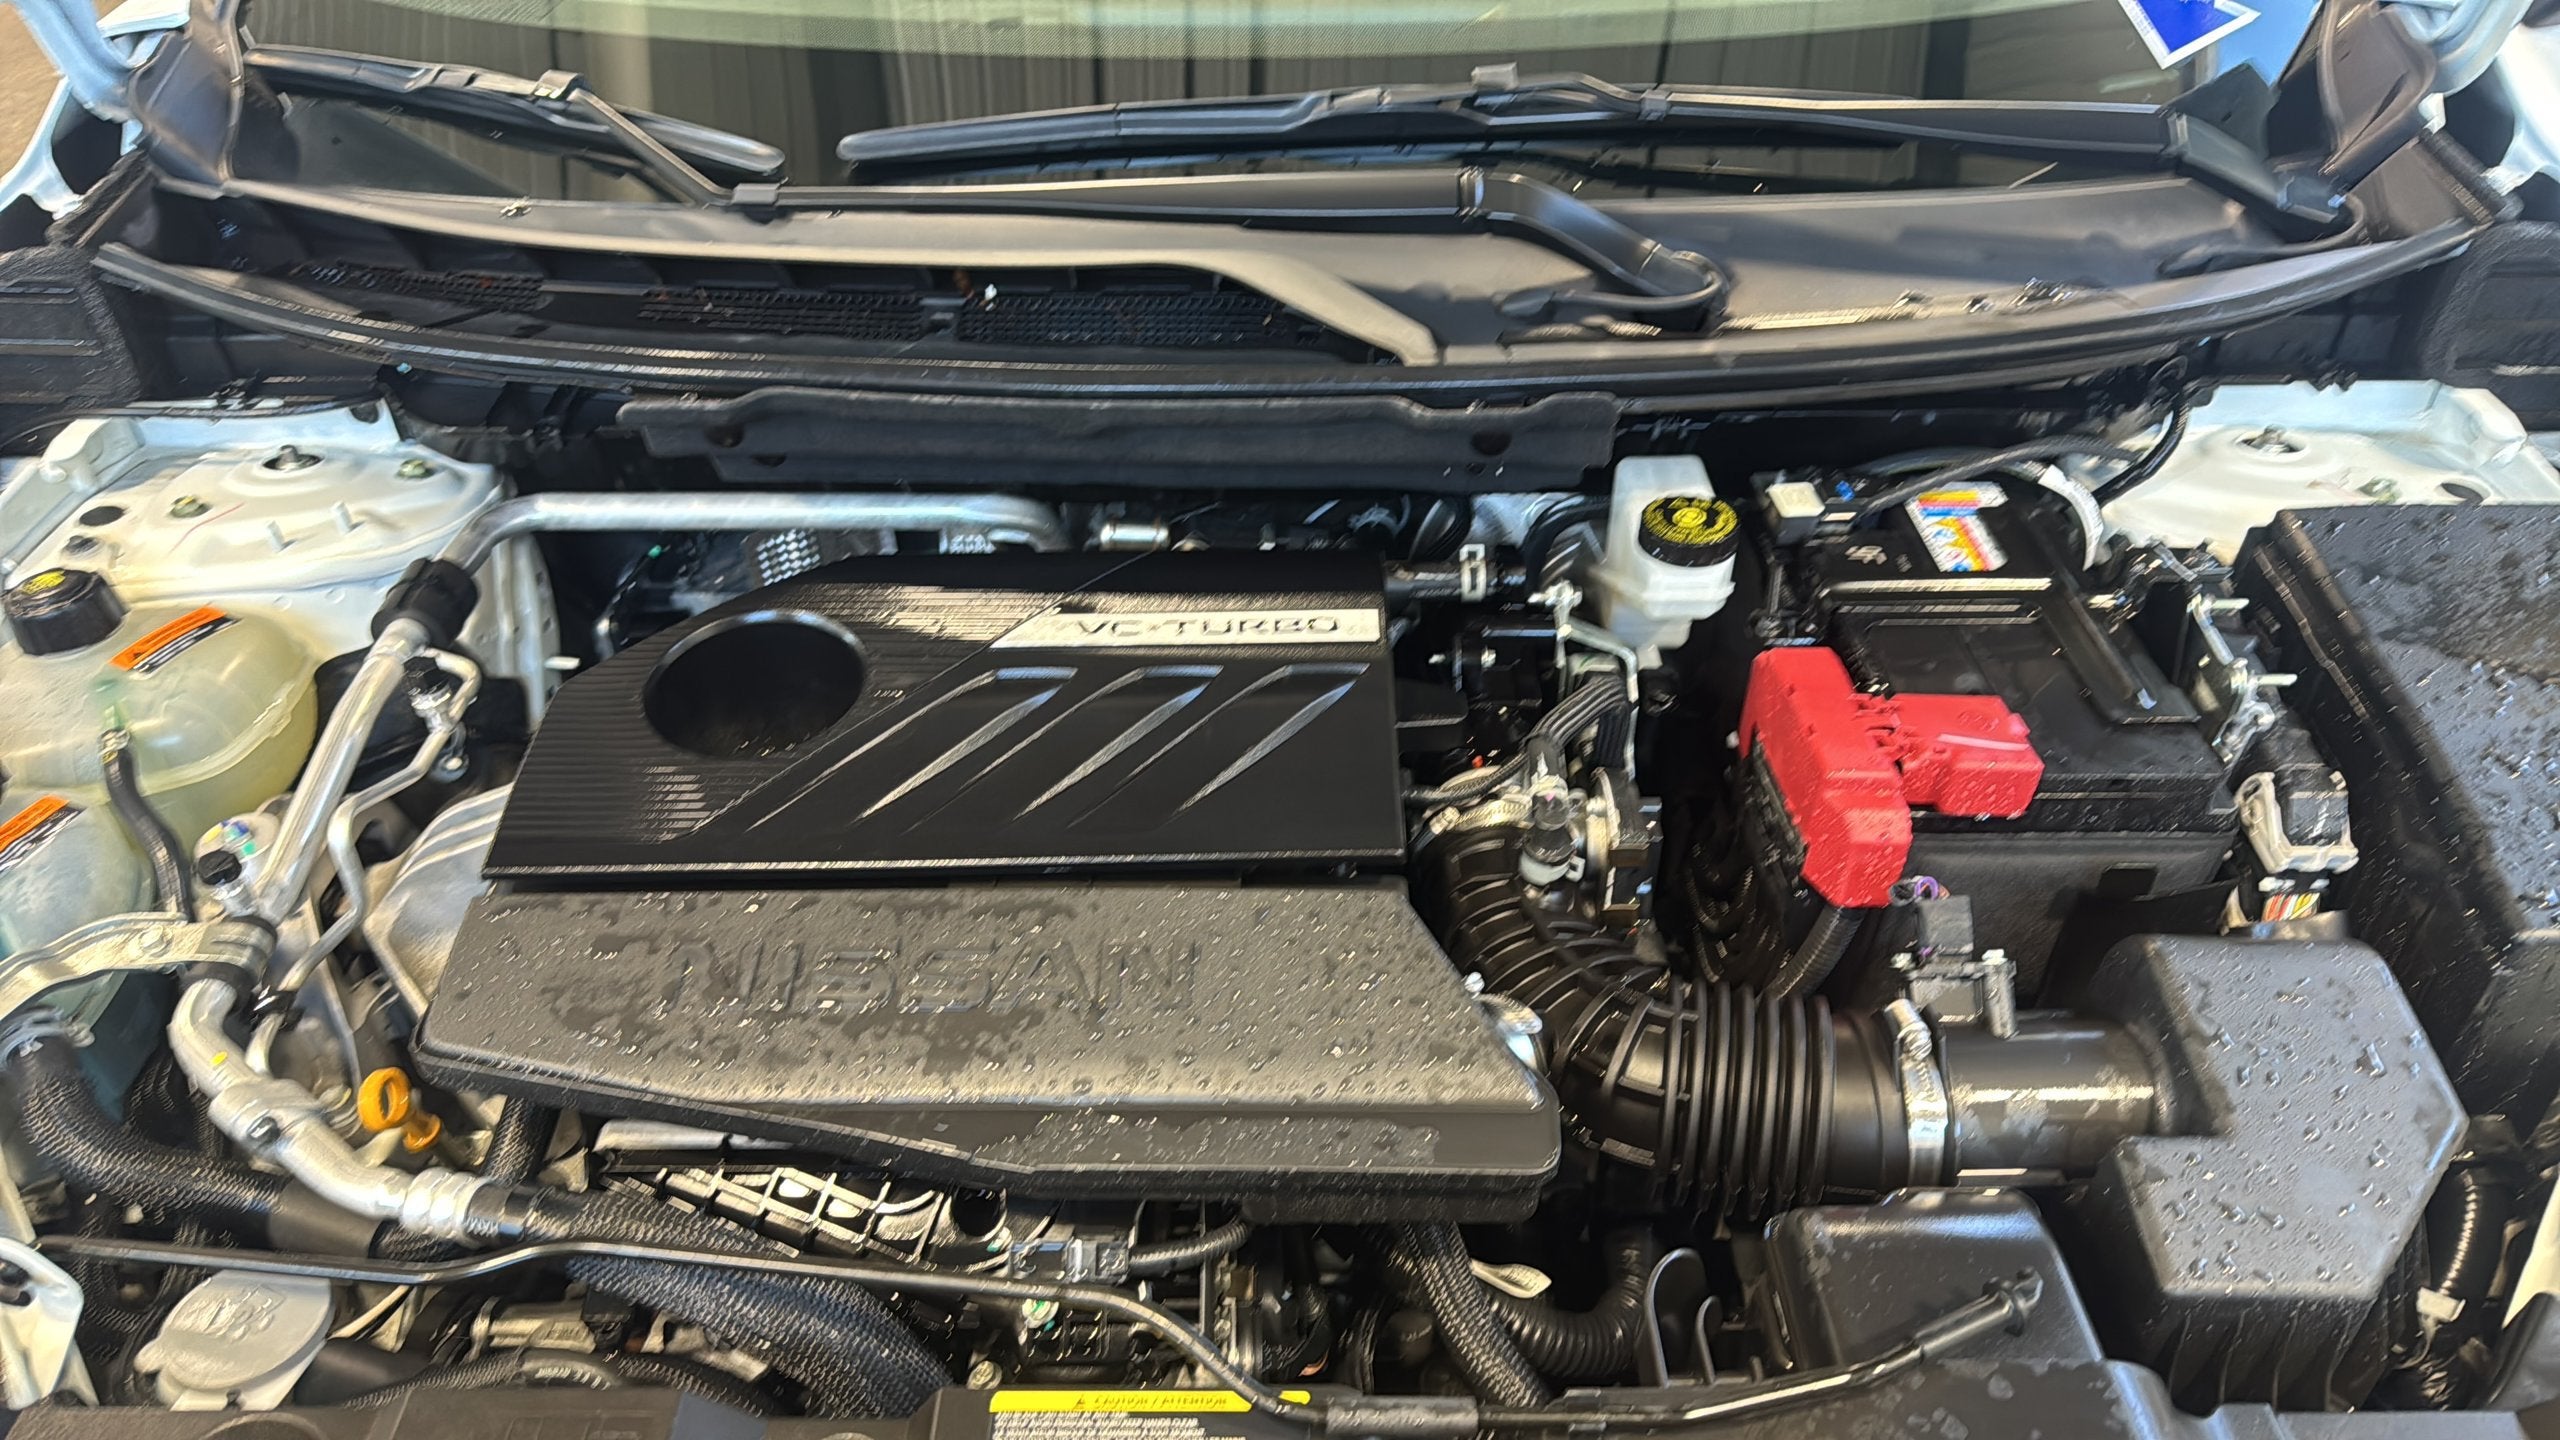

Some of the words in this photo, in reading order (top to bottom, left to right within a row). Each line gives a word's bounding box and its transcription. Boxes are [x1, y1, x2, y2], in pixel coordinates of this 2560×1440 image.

[664, 938, 1198, 1016] NISSAN
[1094, 1393, 1148, 1409] CAUTION
[1161, 1393, 1228, 1409] ATTENTION
